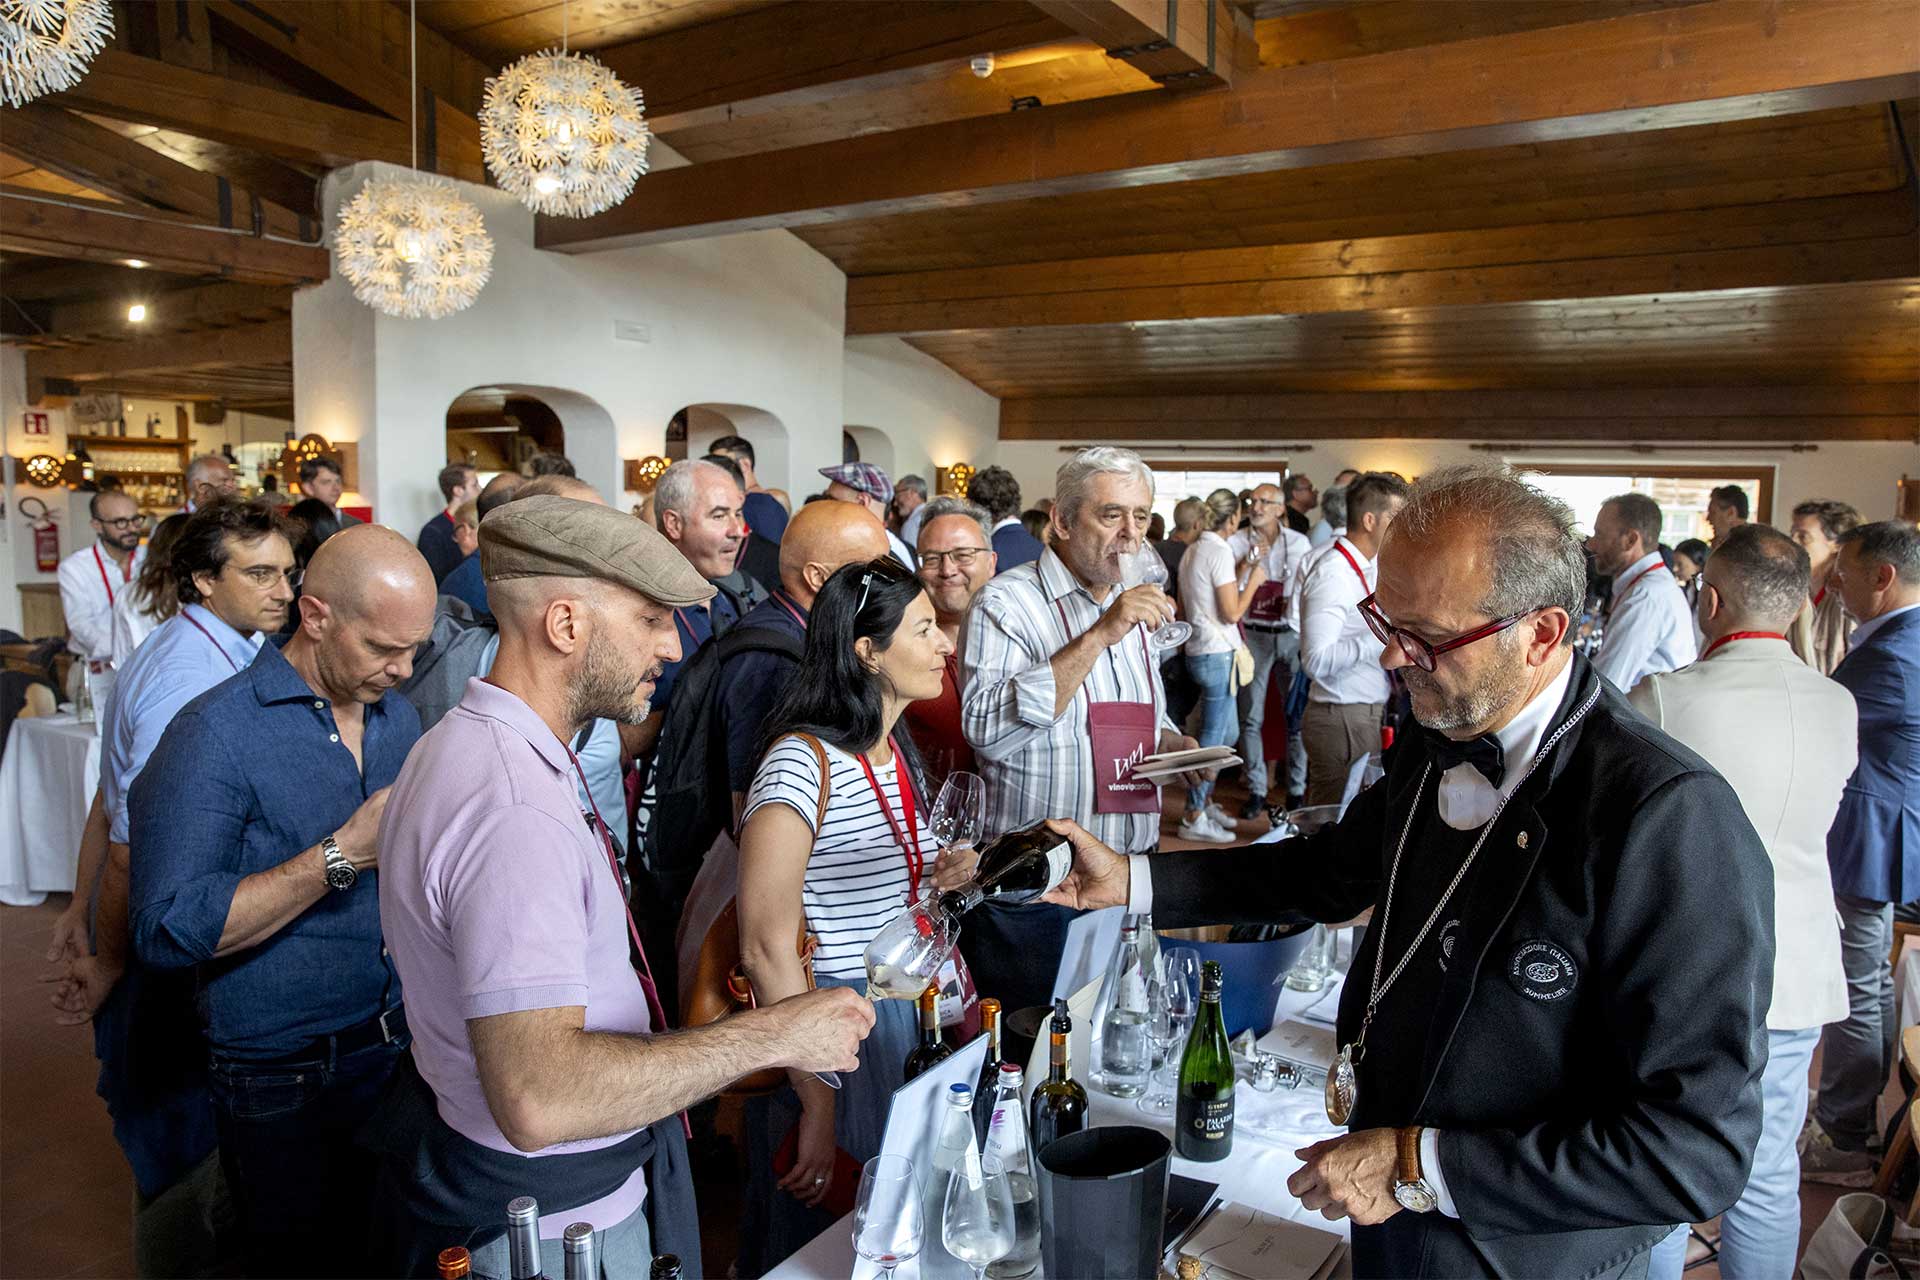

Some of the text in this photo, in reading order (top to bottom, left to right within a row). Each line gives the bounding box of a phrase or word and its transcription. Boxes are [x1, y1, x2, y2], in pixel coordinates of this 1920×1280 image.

[1513, 944, 1574, 977] ASSOCIAZIONE ITALIANA
[1523, 986, 1569, 1000] SOMMELIER
